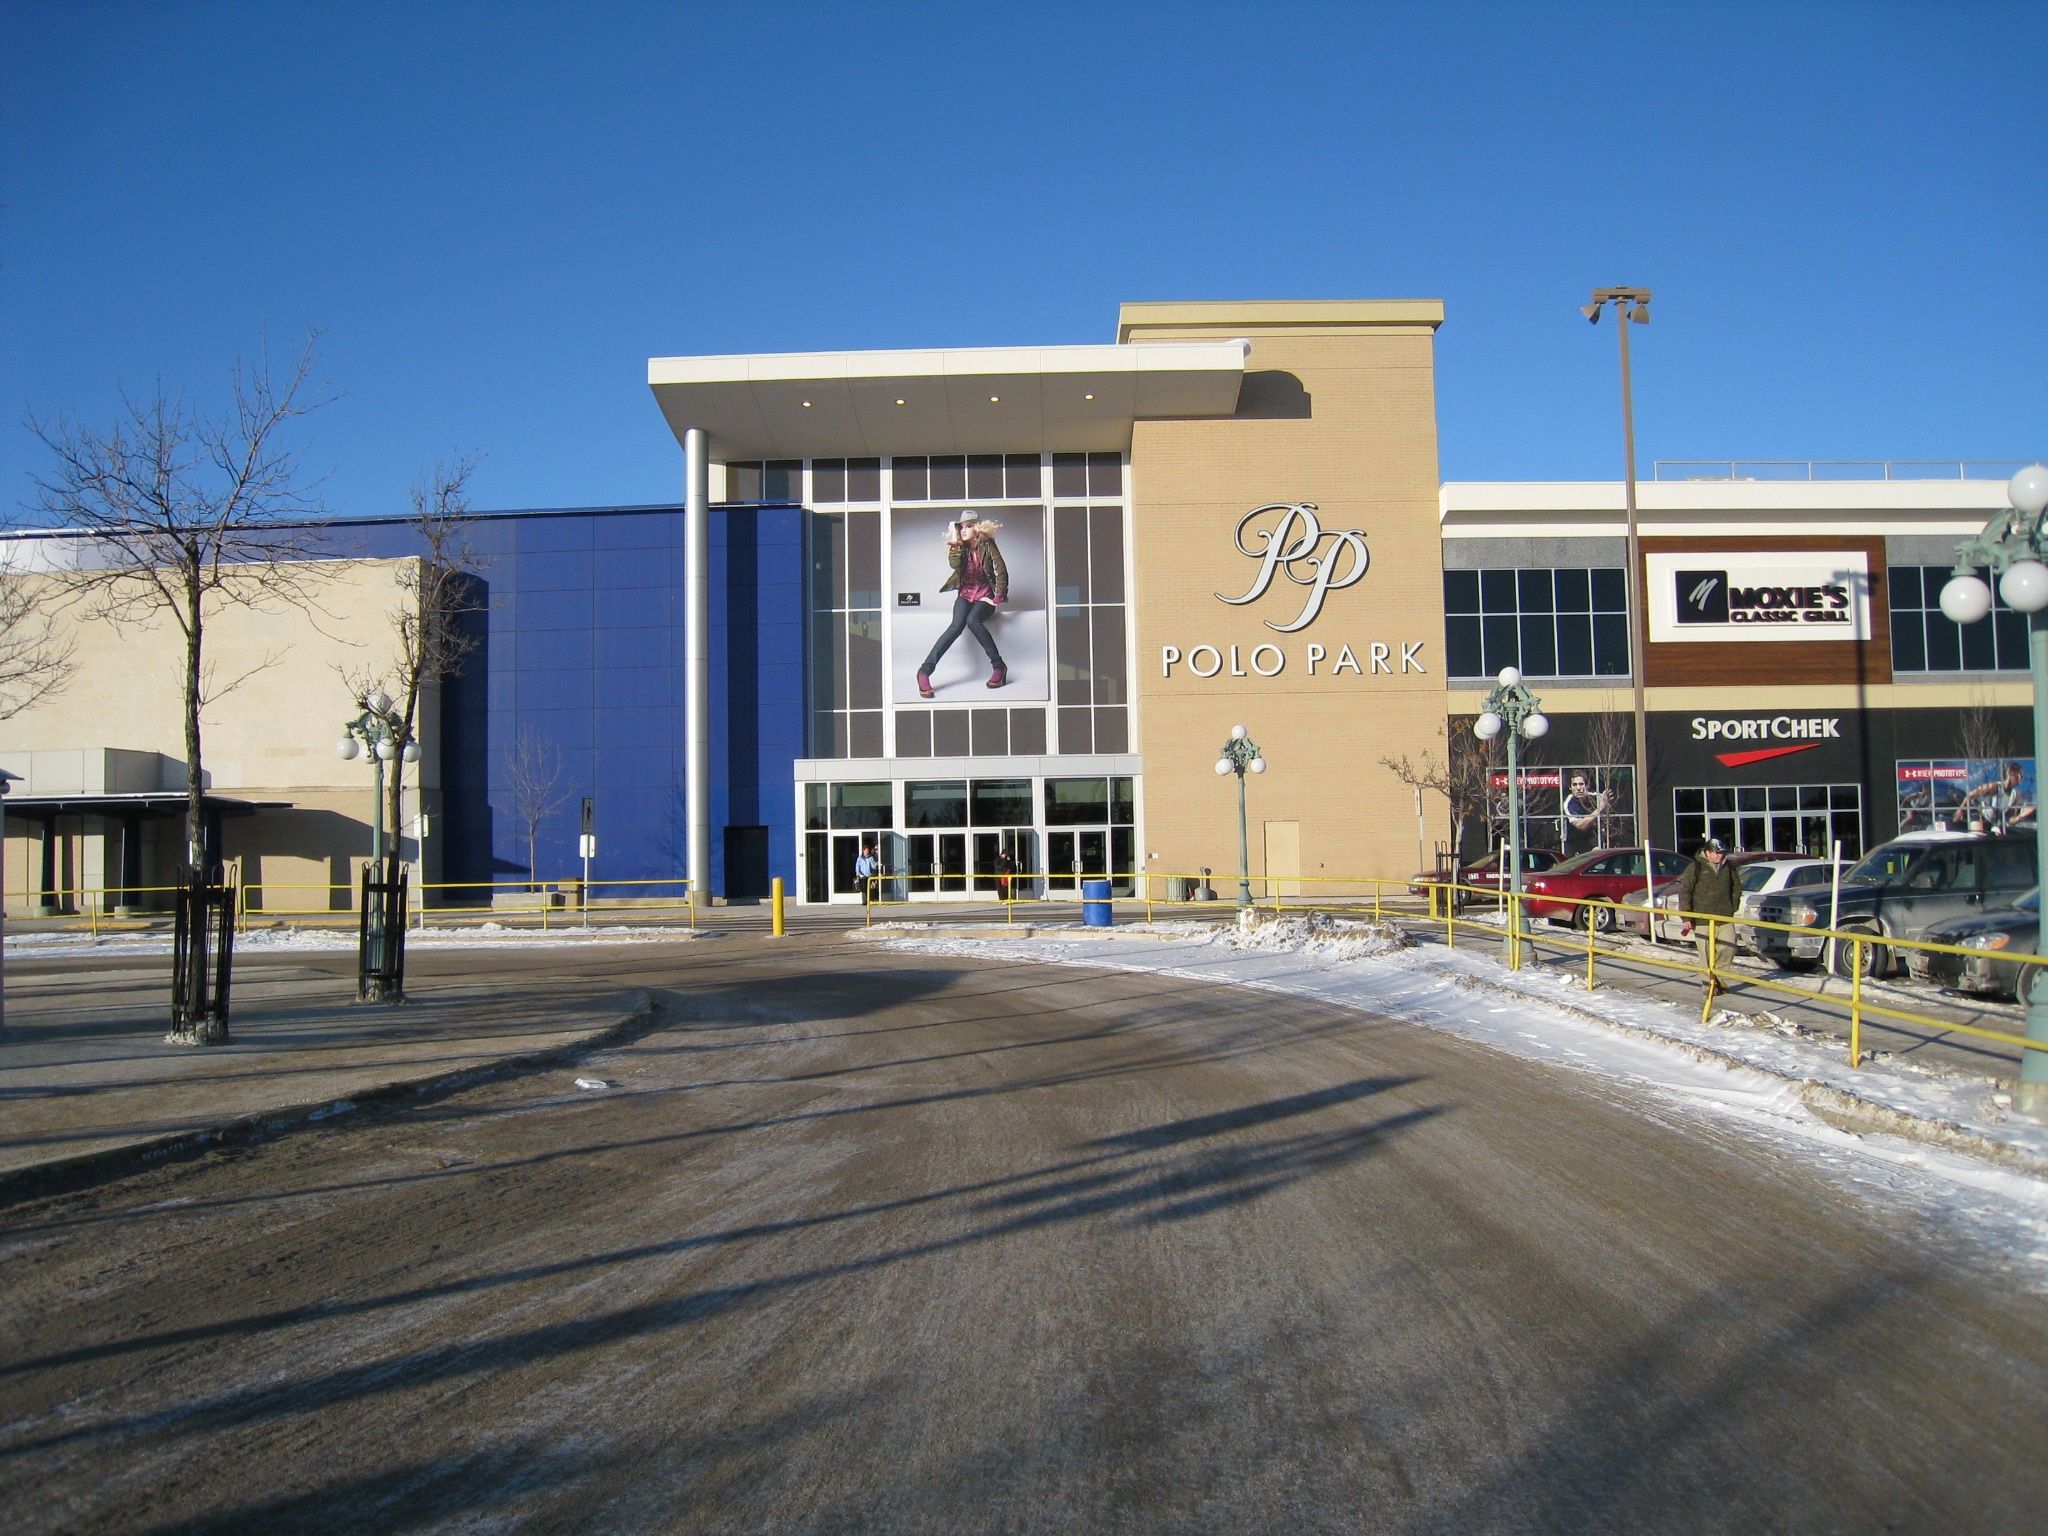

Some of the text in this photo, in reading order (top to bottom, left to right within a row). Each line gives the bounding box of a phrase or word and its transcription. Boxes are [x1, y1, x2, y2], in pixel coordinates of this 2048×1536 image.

[1728, 585, 1849, 609] MOXIE'S
[1730, 610, 1849, 622] CLASSIC GRILL
[1162, 641, 1427, 678] POLO PARK
[1933, 769, 1968, 777] PROTOTYPE
